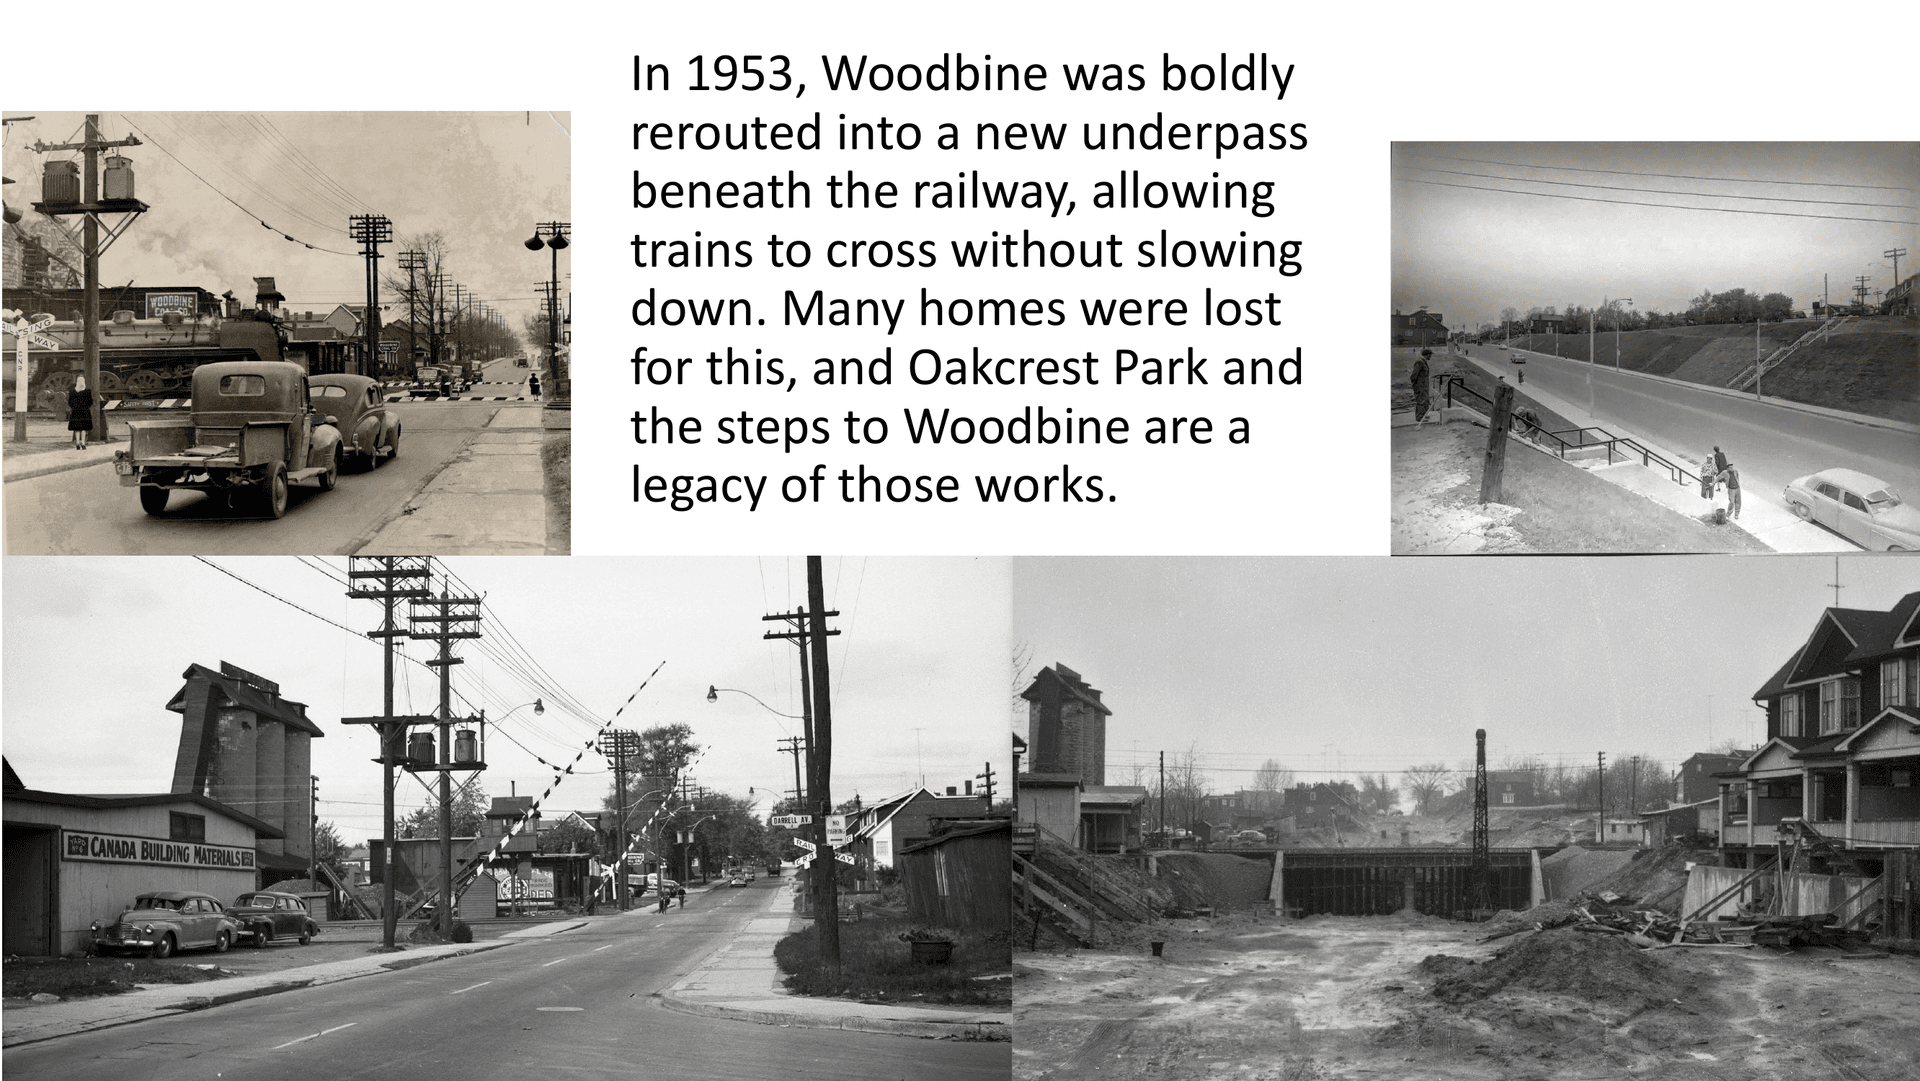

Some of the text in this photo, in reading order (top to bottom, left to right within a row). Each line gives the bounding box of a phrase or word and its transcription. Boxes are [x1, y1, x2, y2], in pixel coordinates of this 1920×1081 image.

[150, 296, 193, 307] WOODBINE
[34, 335, 56, 349] WAY
[774, 816, 798, 825] DARRELL
[796, 839, 815, 851] RAIL
[91, 836, 241, 867] CANADA BUILDING MATERIALS
